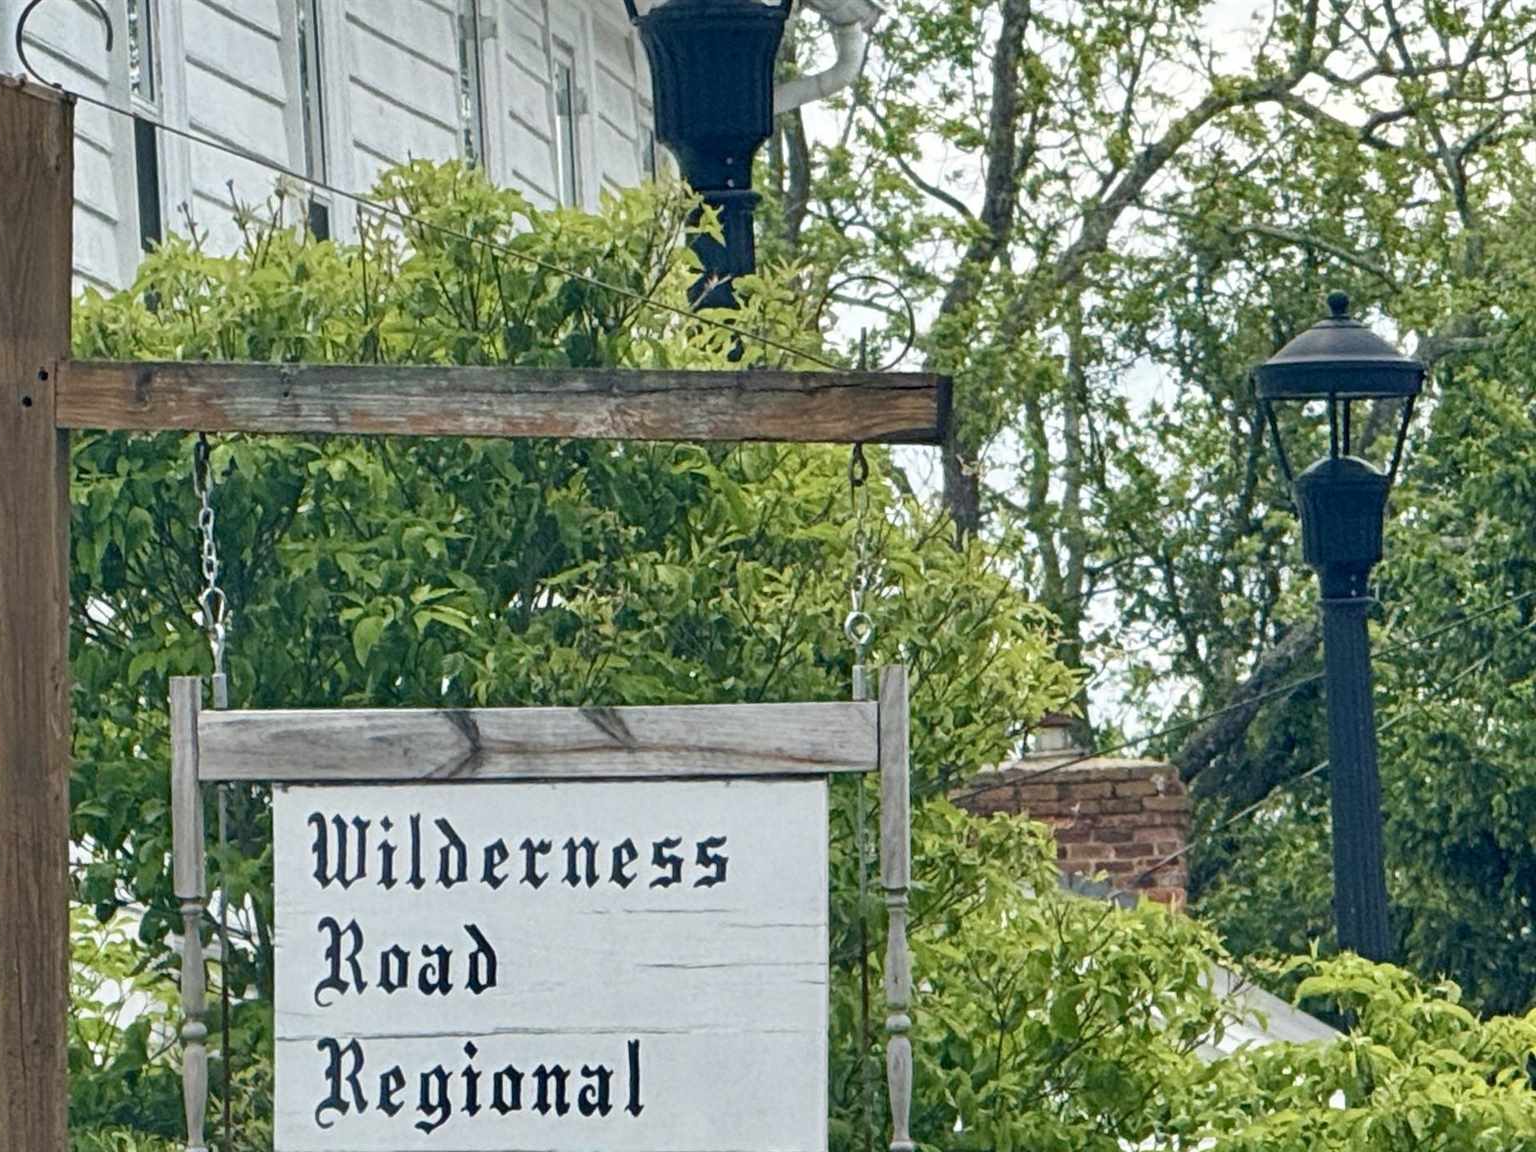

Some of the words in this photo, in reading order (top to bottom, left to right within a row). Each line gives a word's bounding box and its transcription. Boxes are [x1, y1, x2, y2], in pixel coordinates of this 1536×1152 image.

[308, 812, 729, 890] Wilderness
[314, 916, 498, 1007] Road
[314, 1037, 645, 1135] Regional
